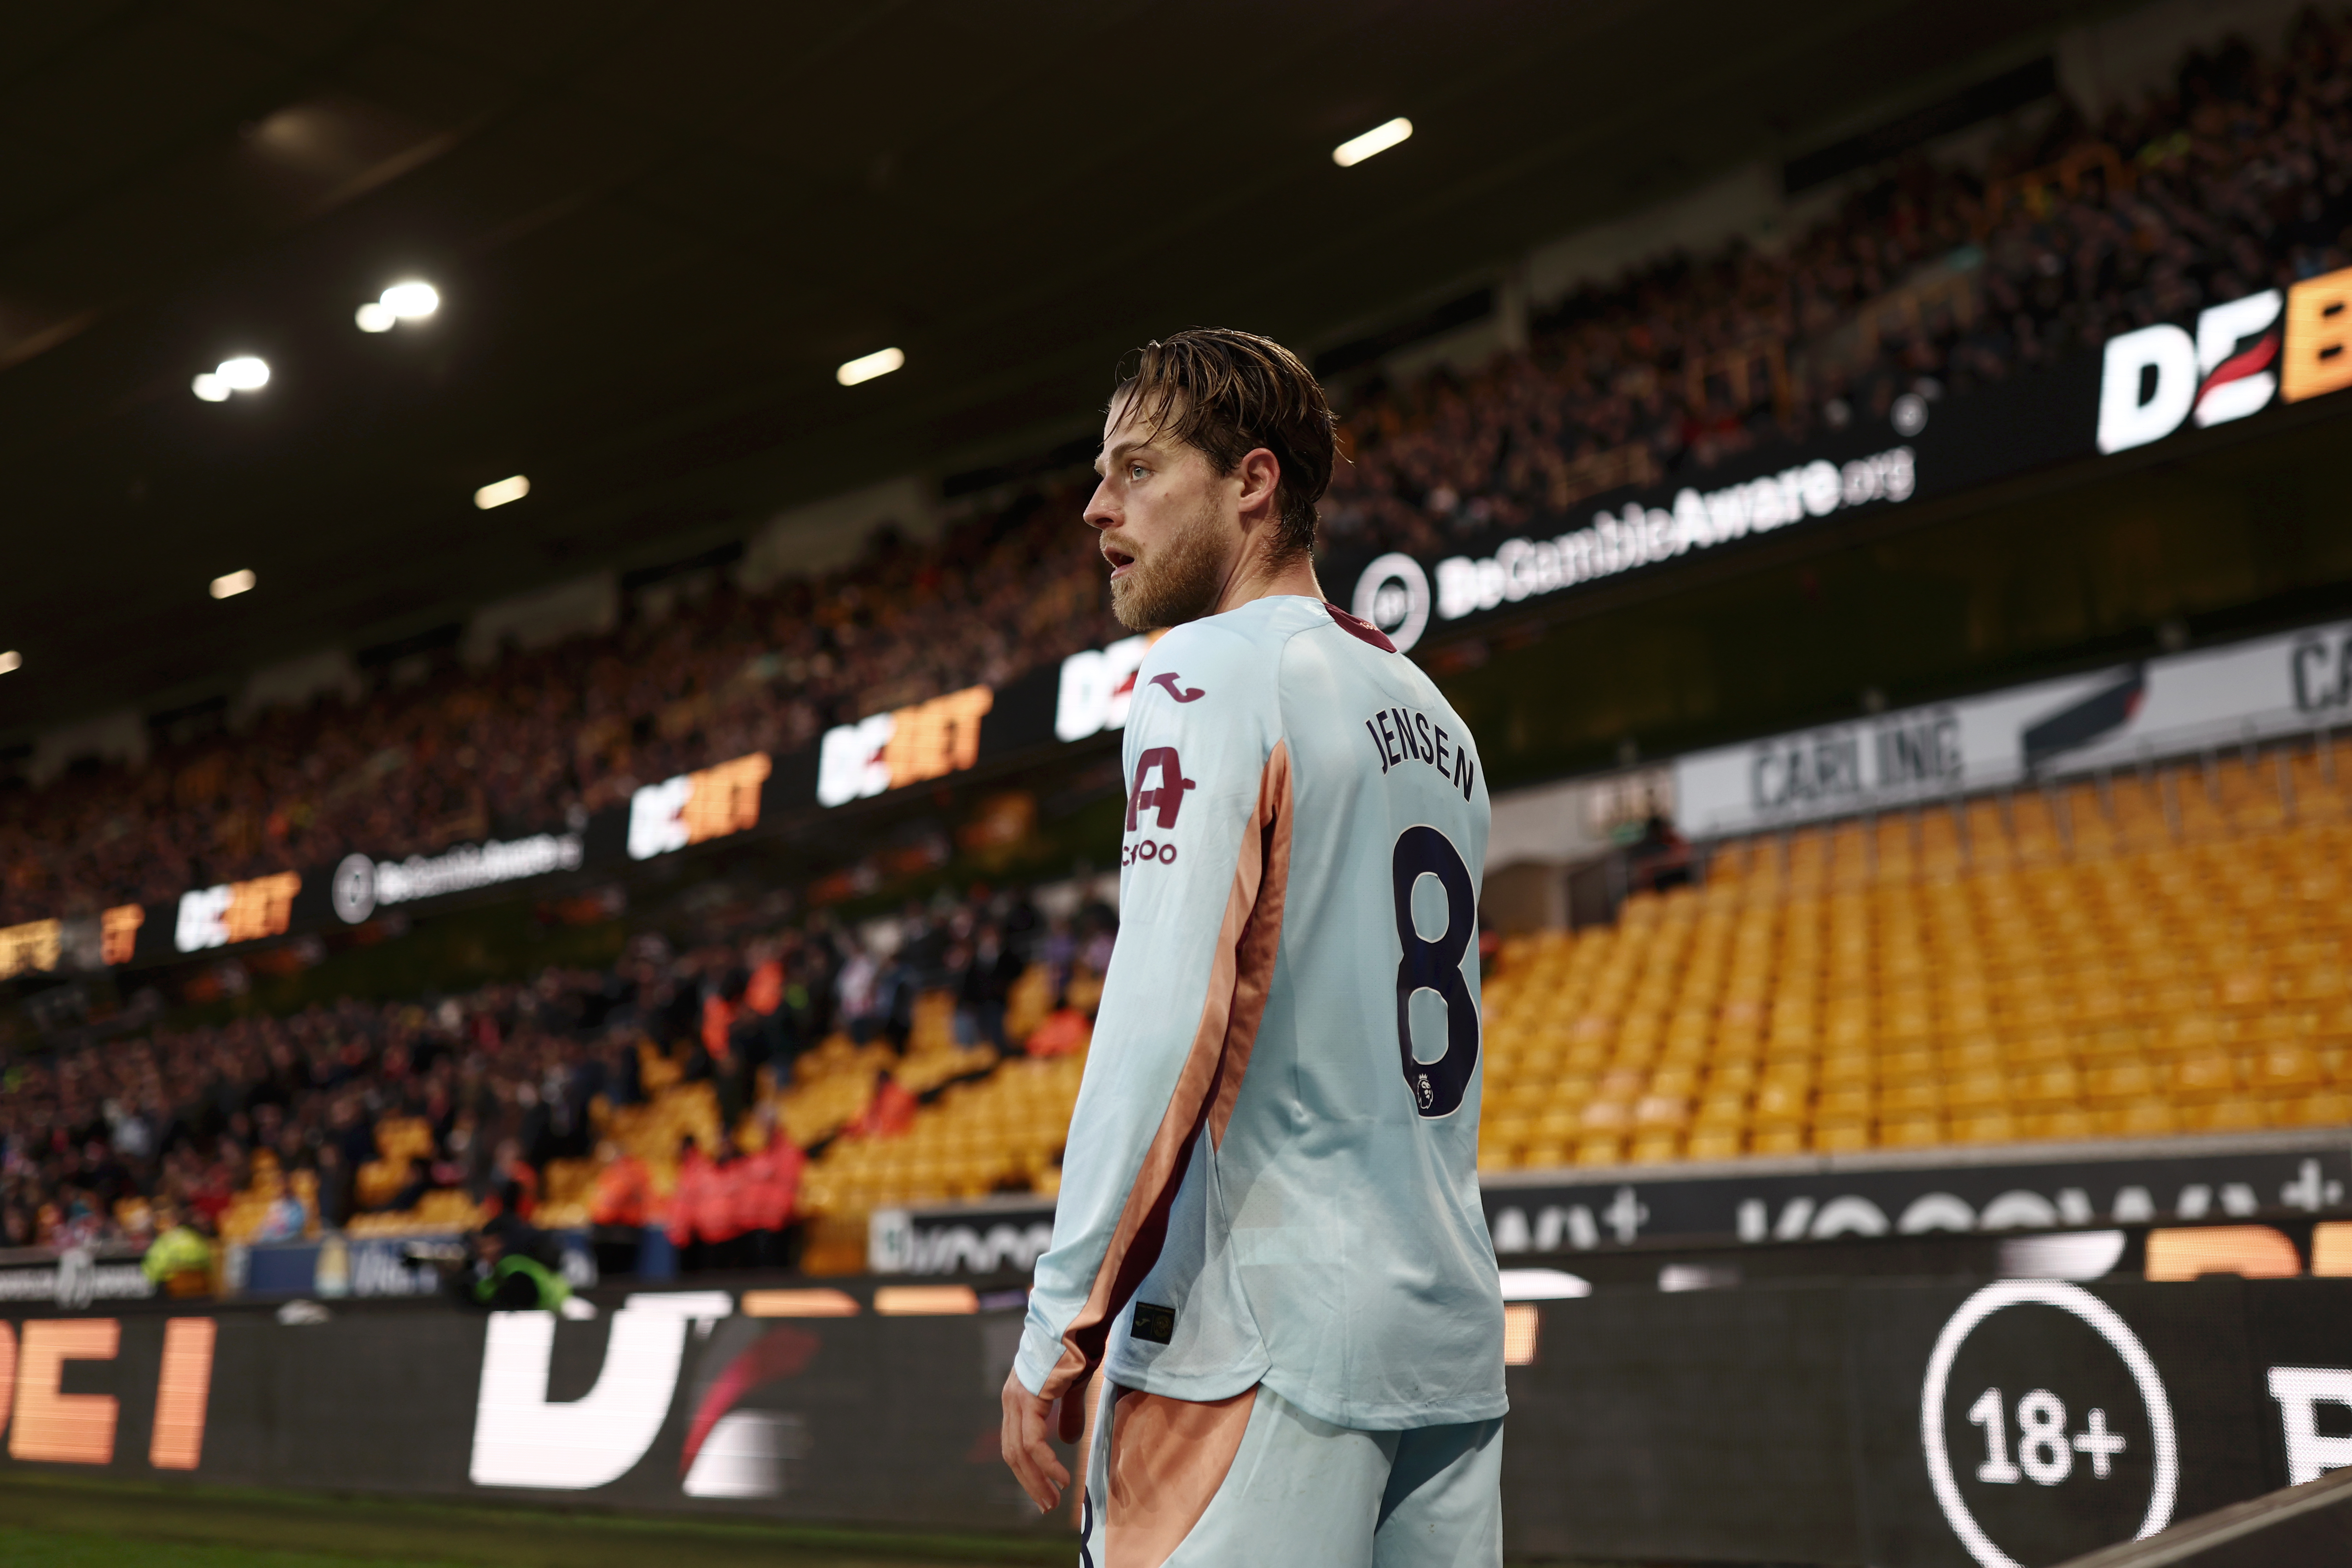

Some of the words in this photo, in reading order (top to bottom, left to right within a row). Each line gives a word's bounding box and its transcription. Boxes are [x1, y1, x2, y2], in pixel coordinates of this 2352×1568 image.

[1365, 706, 1475, 805] JENSEN
[1393, 823, 1481, 1119] 8
[1966, 1386, 2127, 1487] 18+
